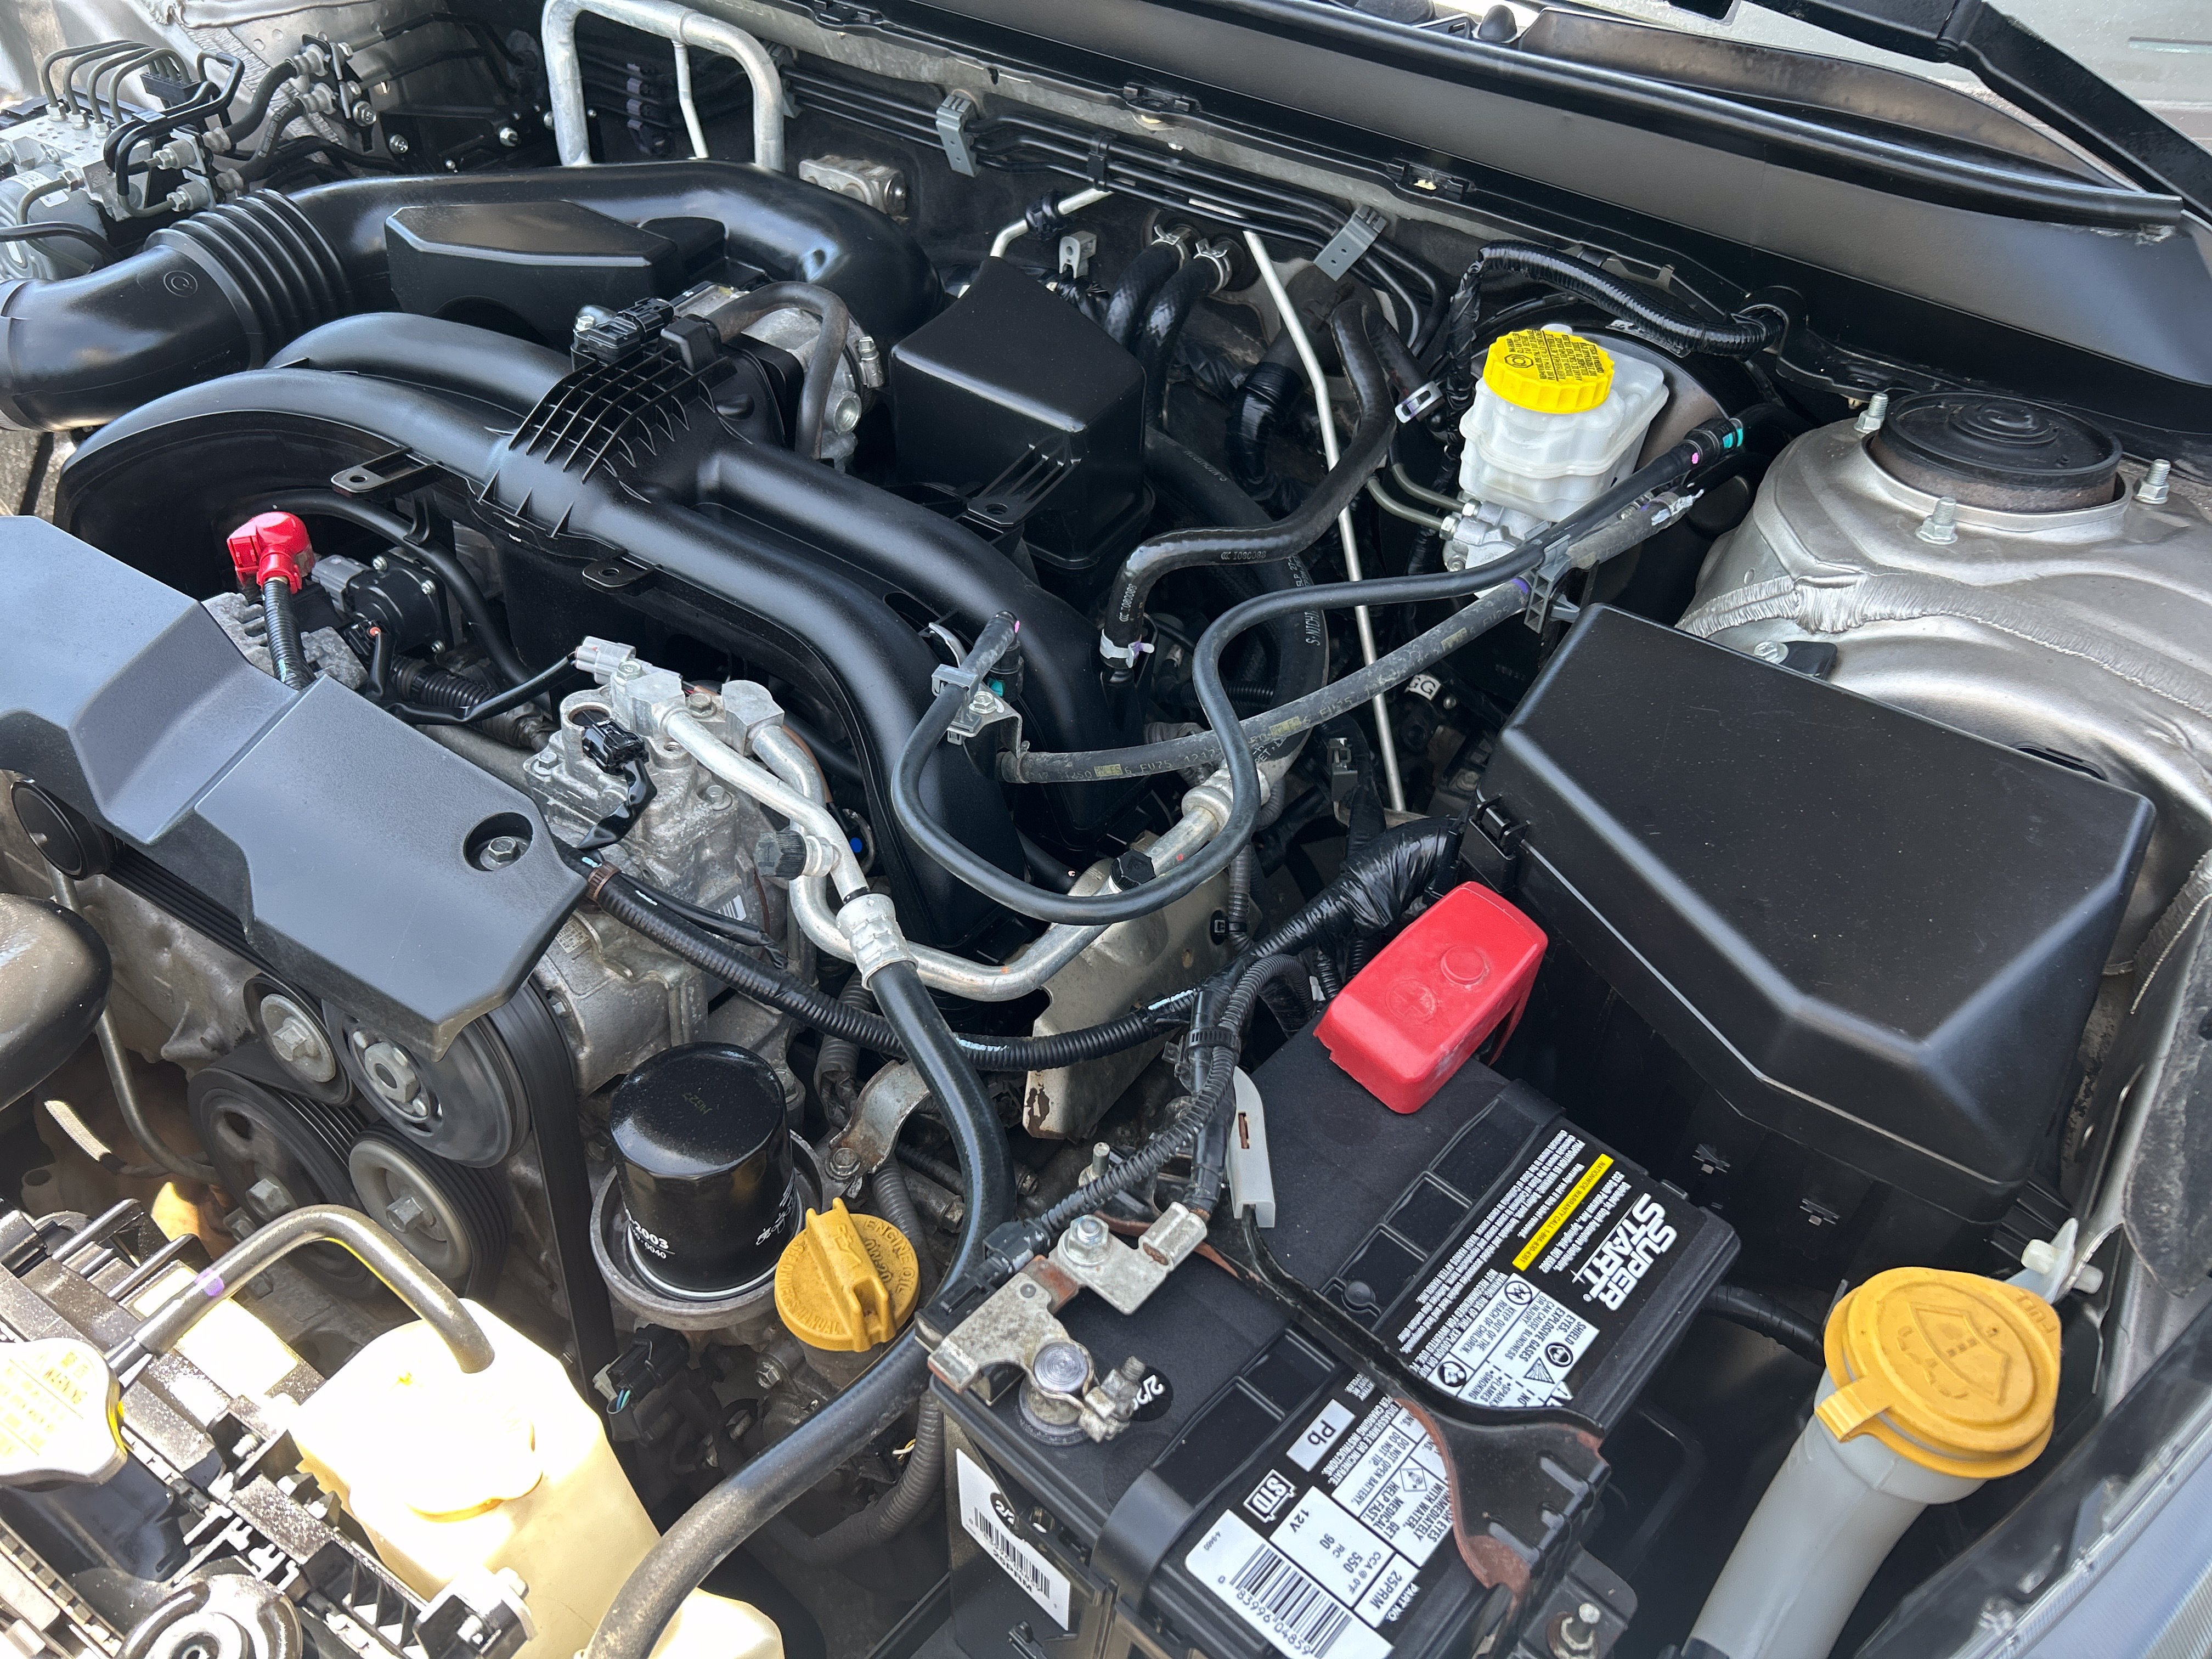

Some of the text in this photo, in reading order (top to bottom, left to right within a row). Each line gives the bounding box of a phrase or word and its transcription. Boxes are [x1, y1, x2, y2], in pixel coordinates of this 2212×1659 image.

[1545, 1127, 1568, 1152] chemicals
[1554, 1133, 1577, 1156] chemicals
[1536, 1146, 1553, 1164] known
[1544, 1151, 1561, 1169] known
[1555, 1138, 1585, 1170] PROPOSITION
[1518, 1169, 1533, 1184] State
[1526, 1174, 1542, 1189] State
[1533, 1169, 1559, 1196] WARNING:
[1561, 1160, 1585, 1186] Warranty
[1578, 1160, 1606, 1191] NATIONWIDE
[1610, 1169, 1625, 1184] 233
[1498, 1183, 1521, 1207] California
[1554, 1181, 1568, 1195] void
[1600, 1178, 1618, 1196] South
[1607, 1180, 1632, 1206] Distributed
[1507, 1188, 1530, 1212] California
[1522, 1190, 1541, 1210] Battery
[1534, 1203, 1550, 1219] label
[1543, 1194, 1557, 1208] this
[1557, 1188, 1583, 1217] WARRANTY
[1584, 1189, 1609, 1216] Patterson
[1485, 1206, 1502, 1223] cause
[1493, 1211, 1510, 1228] cause
[1546, 1214, 1561, 1231] CALL
[1593, 1206, 1610, 1224] Ozark
[1472, 1217, 1492, 1237] cancer.
[1482, 1223, 1500, 1242] cancer
[1496, 1215, 1520, 1240] terminals
[1516, 1215, 1540, 1241] removed.
[1555, 1221, 1583, 1251] Springfield,
[1573, 1218, 1600, 1248] Automotive
[1462, 1232, 1480, 1250] WASH
[1475, 1237, 1488, 1250] and
[1477, 1242, 1497, 1262] related
[1489, 1234, 1504, 1248] and
[1549, 1245, 1564, 1260] MO
[864, 1220, 914, 1293] ENGINE OIL
[1448, 1245, 1468, 1266] HANDS
[1454, 1245, 1482, 1274] reproductive
[1537, 1254, 1557, 1274] 65802
[1595, 1216, 1680, 1314] SUPER
[1436, 1261, 1454, 1281] AFTER
[1443, 1269, 1462, 1288] harm.
[1458, 1256, 1485, 1286] accessories
[1483, 1267, 1498, 1282] NOT
[1414, 1276, 1442, 1306] HANDLING.
[1427, 1282, 1451, 1306] Batteries
[1444, 1280, 1465, 1301] contain
[1481, 1270, 1509, 1300] WARNING:
[1419, 1301, 1434, 1316] also
[1437, 1296, 1452, 1311] lead
[1453, 1277, 1489, 1319] RECOMMENDED
[1471, 1295, 1489, 1312] RISK
[1519, 1293, 1547, 1326] OR INJURY.
[1406, 1310, 1426, 1331] contain
[1421, 1314, 1437, 1330] lead
[1429, 1306, 1444, 1319] and
[1444, 1313, 1460, 1329] FOR
[1465, 1307, 1479, 1319] OF
[1395, 1326, 1413, 1344] other
[1458, 1298, 1508, 1356] REACH OF CHILDREN.
[1475, 1304, 1517, 1352] KEEP OUT OF THE
[1503, 1299, 1555, 1361] CAN CAUSE BLINDNESS
[1517, 1305, 1566, 1363] EXPLOSIVE GASES
[1555, 1313, 1576, 1336] EYES.
[1563, 1320, 1587, 1346] SHIELD
[1399, 1324, 1428, 1356] compounds,
[1424, 1324, 1452, 1354] INVERTED
[1432, 1327, 1462, 1360] EXPLOSION
[1413, 1348, 1431, 1367] USE.
[1426, 1355, 1440, 1368] OR
[1516, 1391, 1531, 1406] NO
[1355, 1403, 1385, 1436] CHARGING
[1362, 1402, 1400, 1445] DISASSEMBLE
[1305, 1418, 1337, 1451] Pb
[1387, 1430, 1401, 1444] DO
[1396, 1437, 1410, 1451] DO
[1319, 1431, 1362, 1479] INSTRUCTIONS.
[1355, 1440, 1369, 1454] OR
[1377, 1439, 1393, 1457] NOT
[1385, 1446, 1402, 1464] NOT
[1327, 1448, 1362, 1488] INCINERATE.
[1372, 1459, 1392, 1480] OPEN
[1249, 1474, 1288, 1516] STD
[1350, 1475, 1379, 1508] BATTERY.
[1362, 1480, 1400, 1524] HELP FAST.
[1423, 1481, 1446, 1505] WITH
[1286, 1506, 1311, 1533] 12V
[1372, 1495, 1404, 1532] MEDICAL
[1401, 1499, 1431, 1532] WATER.
[1318, 1532, 1336, 1551] 90
[1381, 1520, 1401, 1540] GET
[1425, 1519, 1448, 1543] EYES
[1330, 1543, 1346, 1559] RC
[1341, 1550, 1364, 1575] 550
[1363, 1550, 1383, 1571] CCA
[1368, 1569, 1404, 1610] 25PRM
[1384, 1582, 1419, 1624] PART NO.
[1234, 1588, 1273, 1624] 83996
[1272, 1620, 1312, 1658] 04859
